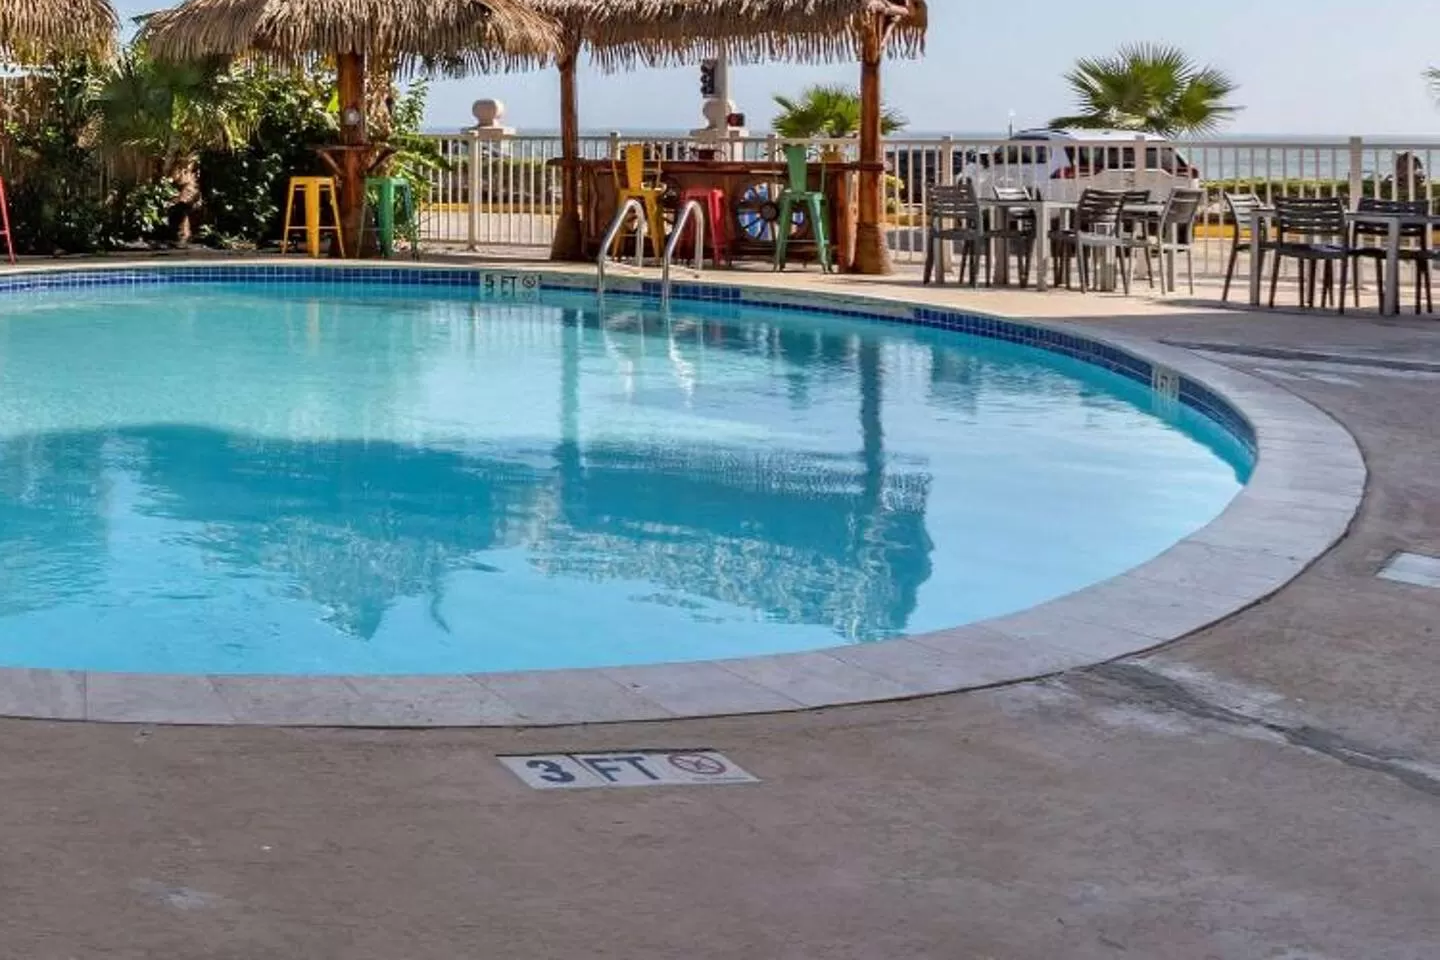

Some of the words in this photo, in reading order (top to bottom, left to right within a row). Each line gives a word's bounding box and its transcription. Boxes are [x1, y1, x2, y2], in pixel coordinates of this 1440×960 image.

[501, 275, 517, 290] FT
[526, 760, 575, 782] 3
[583, 756, 659, 781] FT
